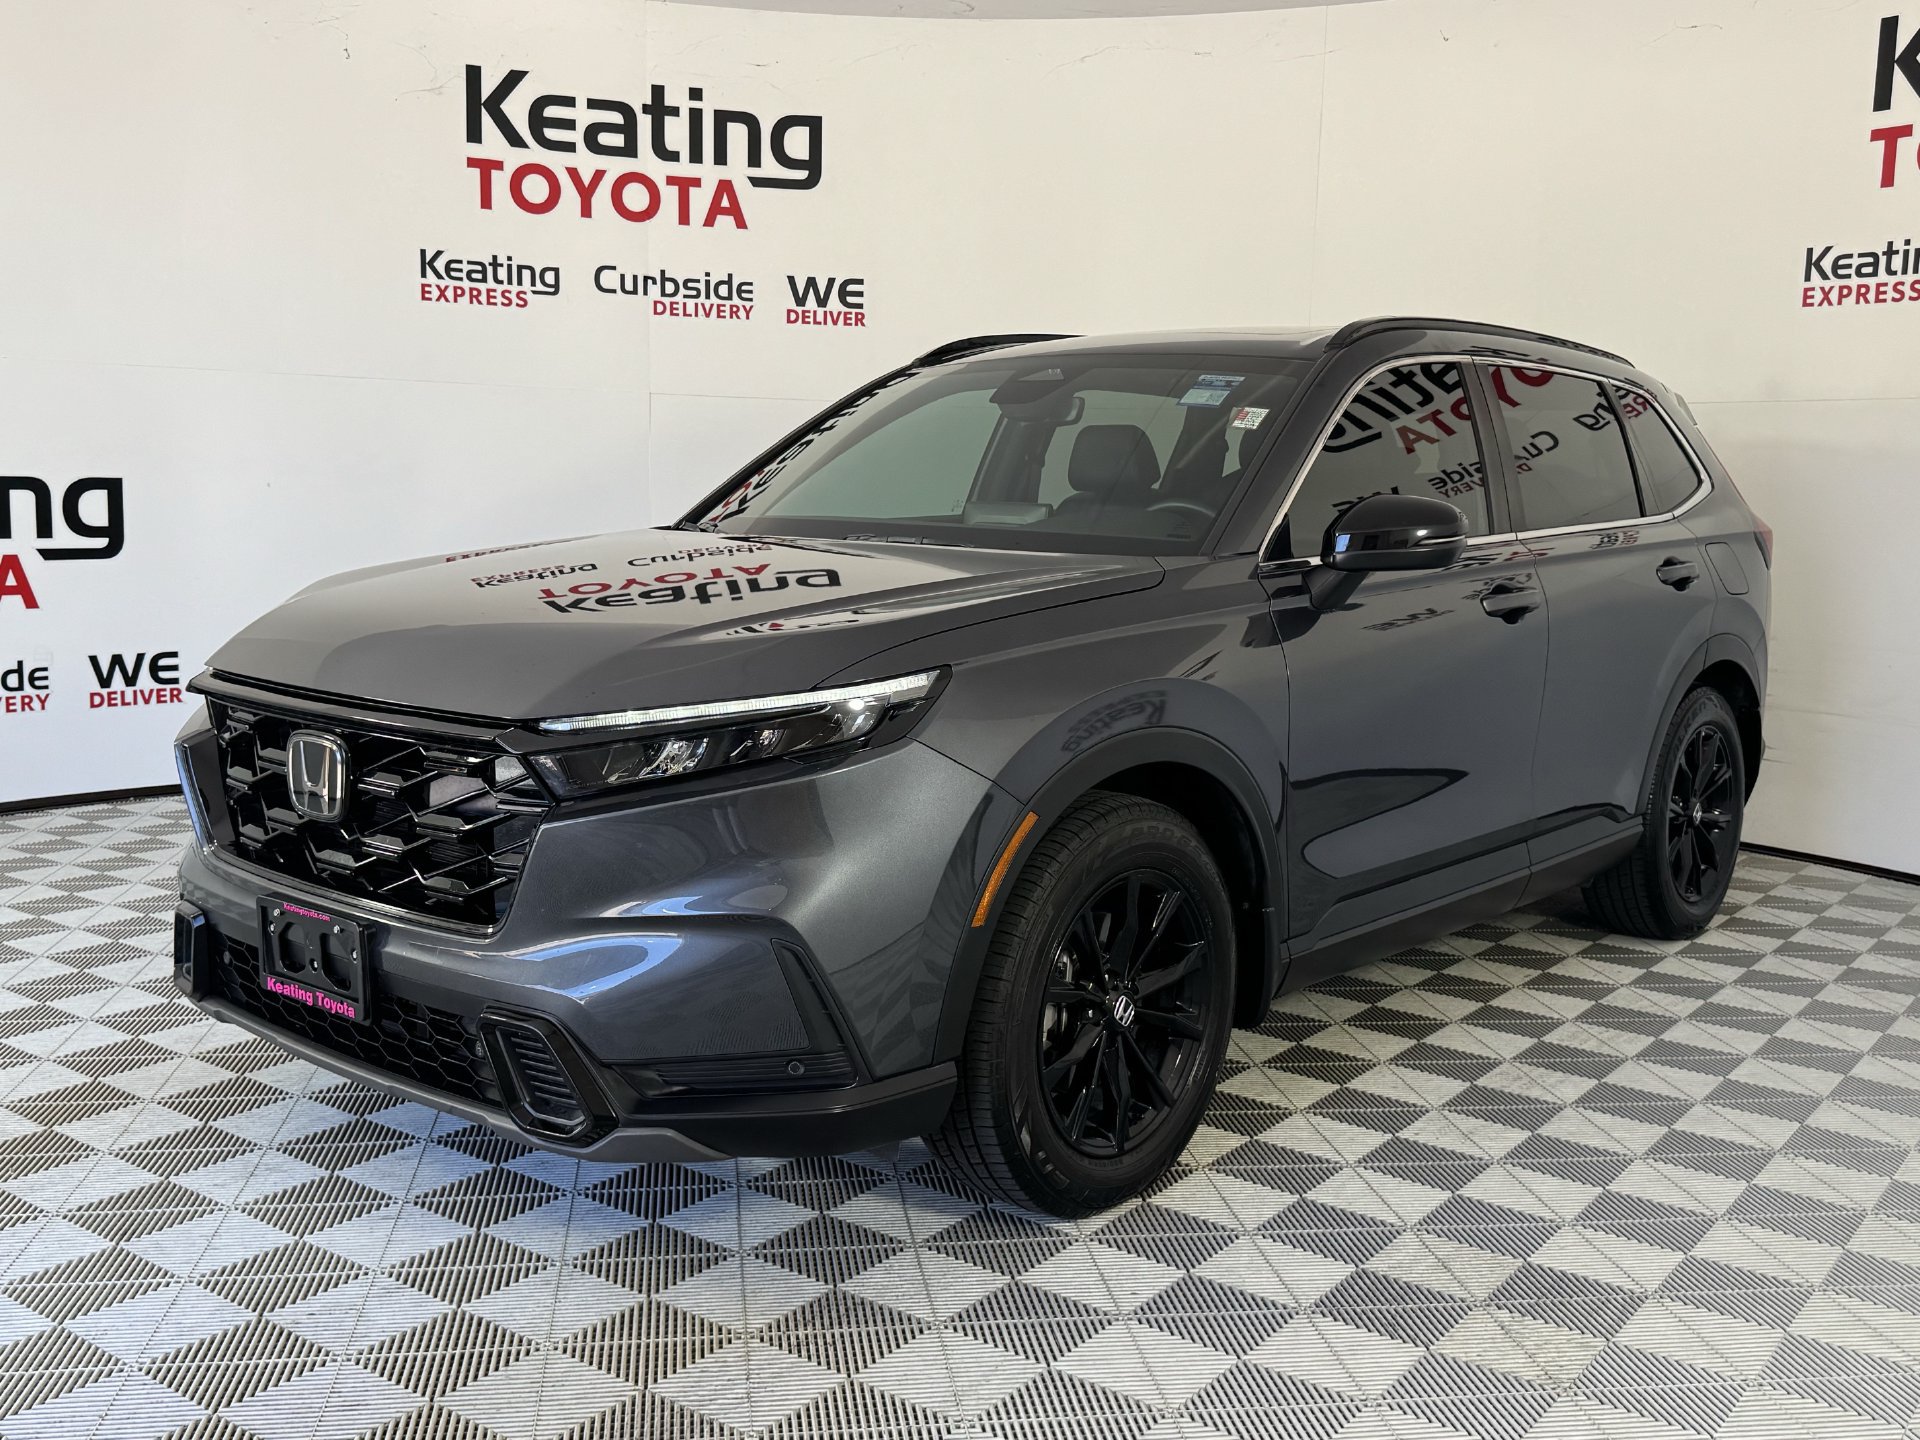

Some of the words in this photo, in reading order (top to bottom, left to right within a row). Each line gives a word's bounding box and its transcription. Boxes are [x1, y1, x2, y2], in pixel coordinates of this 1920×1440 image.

[465, 64, 823, 190] Keating
[466, 156, 748, 230] TOYOTA
[419, 248, 560, 296] Keating
[594, 265, 754, 302] Curbside
[786, 275, 865, 310] WE
[420, 283, 529, 309] EXPRESS
[652, 299, 754, 321] DELIVERY
[786, 308, 866, 328] DELIVER
[87, 651, 181, 690] WE
[89, 687, 183, 709] DELIVER
[266, 976, 314, 1006] Keating
[316, 992, 355, 1018] Toyota
